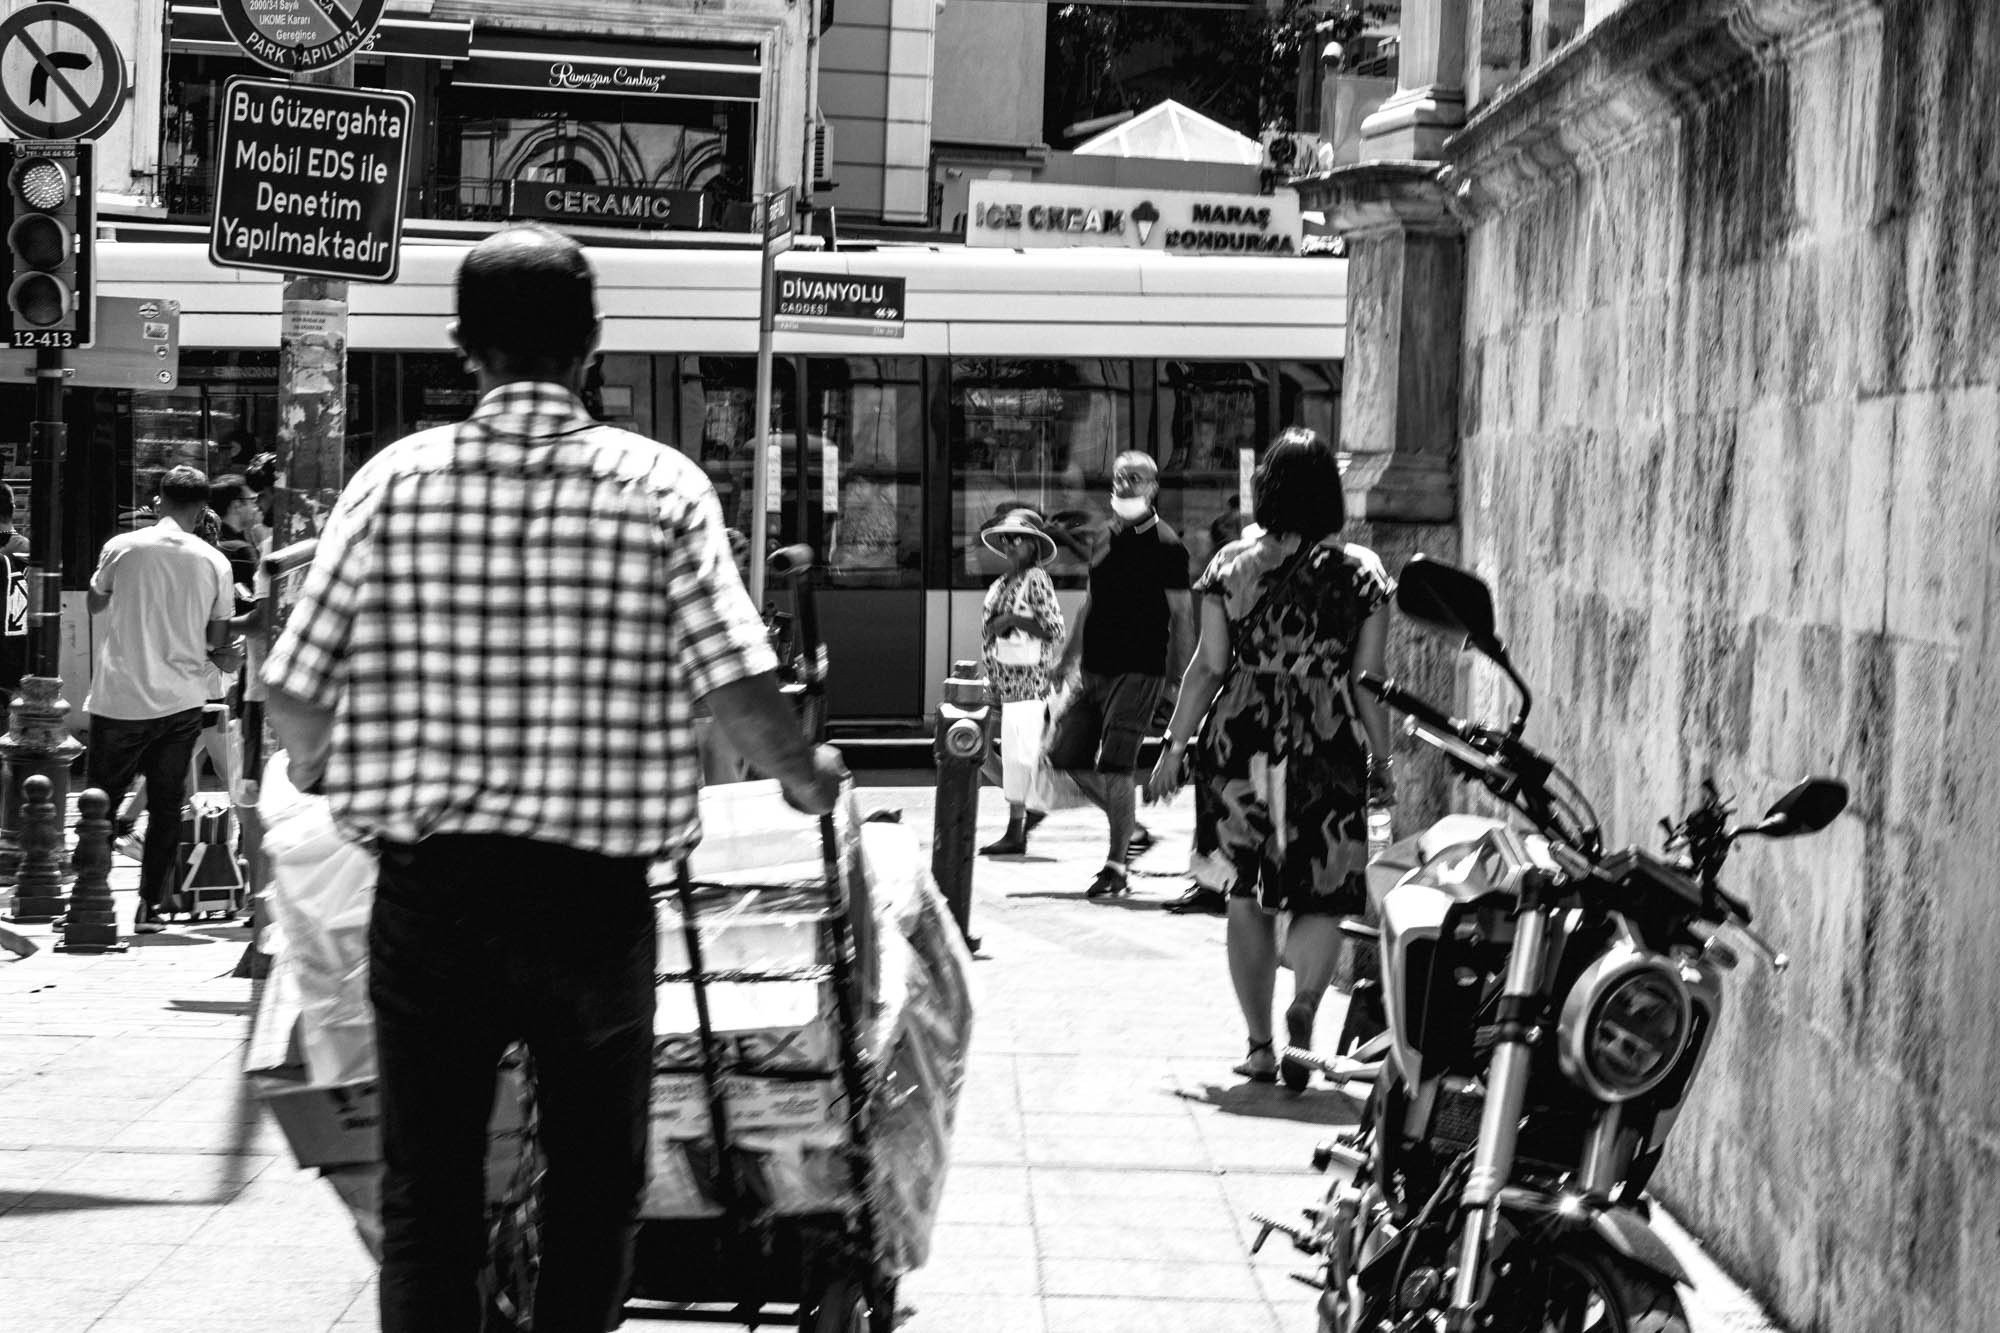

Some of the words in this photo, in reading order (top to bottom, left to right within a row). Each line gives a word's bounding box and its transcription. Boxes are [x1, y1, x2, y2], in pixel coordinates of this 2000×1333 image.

[259, 14, 286, 25] UKOME
[245, 31, 287, 64] PARK
[291, 20, 366, 66] YAPILMAZ
[549, 62, 611, 88] Ramazan
[613, 66, 661, 93] Canbaz
[233, 91, 264, 124] Bu
[270, 95, 401, 141] Güzergahta
[235, 139, 301, 176] Mobil
[307, 147, 355, 181] EDS
[360, 153, 388, 184] ile
[256, 181, 362, 221] Denetim
[544, 189, 671, 219] CERAMIC
[975, 200, 1023, 231] ICE
[1191, 203, 1272, 232] MARAŞ
[222, 216, 389, 263] Yapılmaktadır
[782, 276, 884, 304] DİVANYOLU
[779, 302, 828, 316] CADDESİ
[13, 332, 73, 348] 12-413
